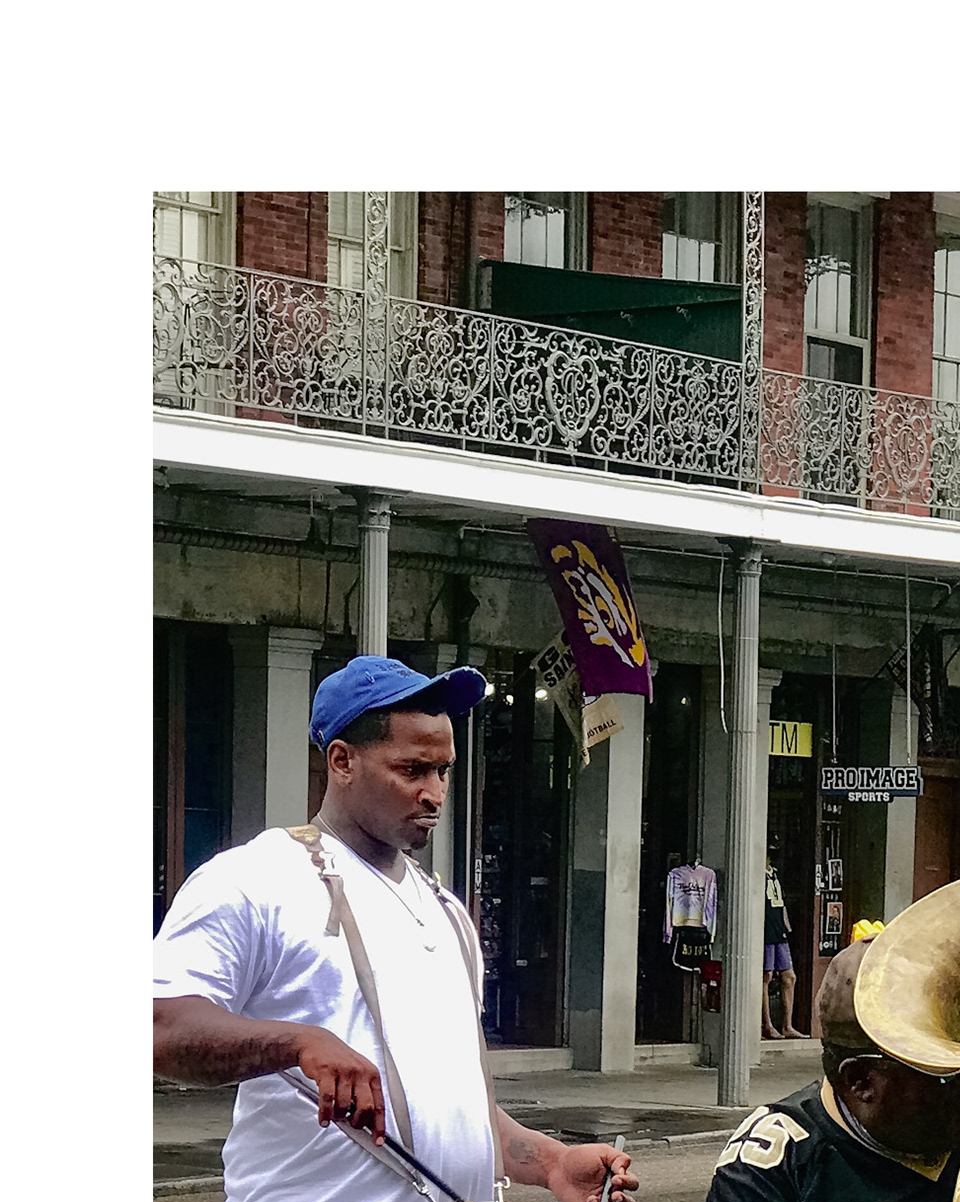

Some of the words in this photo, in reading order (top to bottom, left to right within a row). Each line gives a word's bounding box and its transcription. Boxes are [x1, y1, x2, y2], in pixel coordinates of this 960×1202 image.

[543, 648, 576, 688] SAIN
[587, 719, 617, 739] OTBALL
[769, 722, 798, 755] TM
[858, 767, 918, 790] IMAGE
[848, 791, 890, 802] SPORTS
